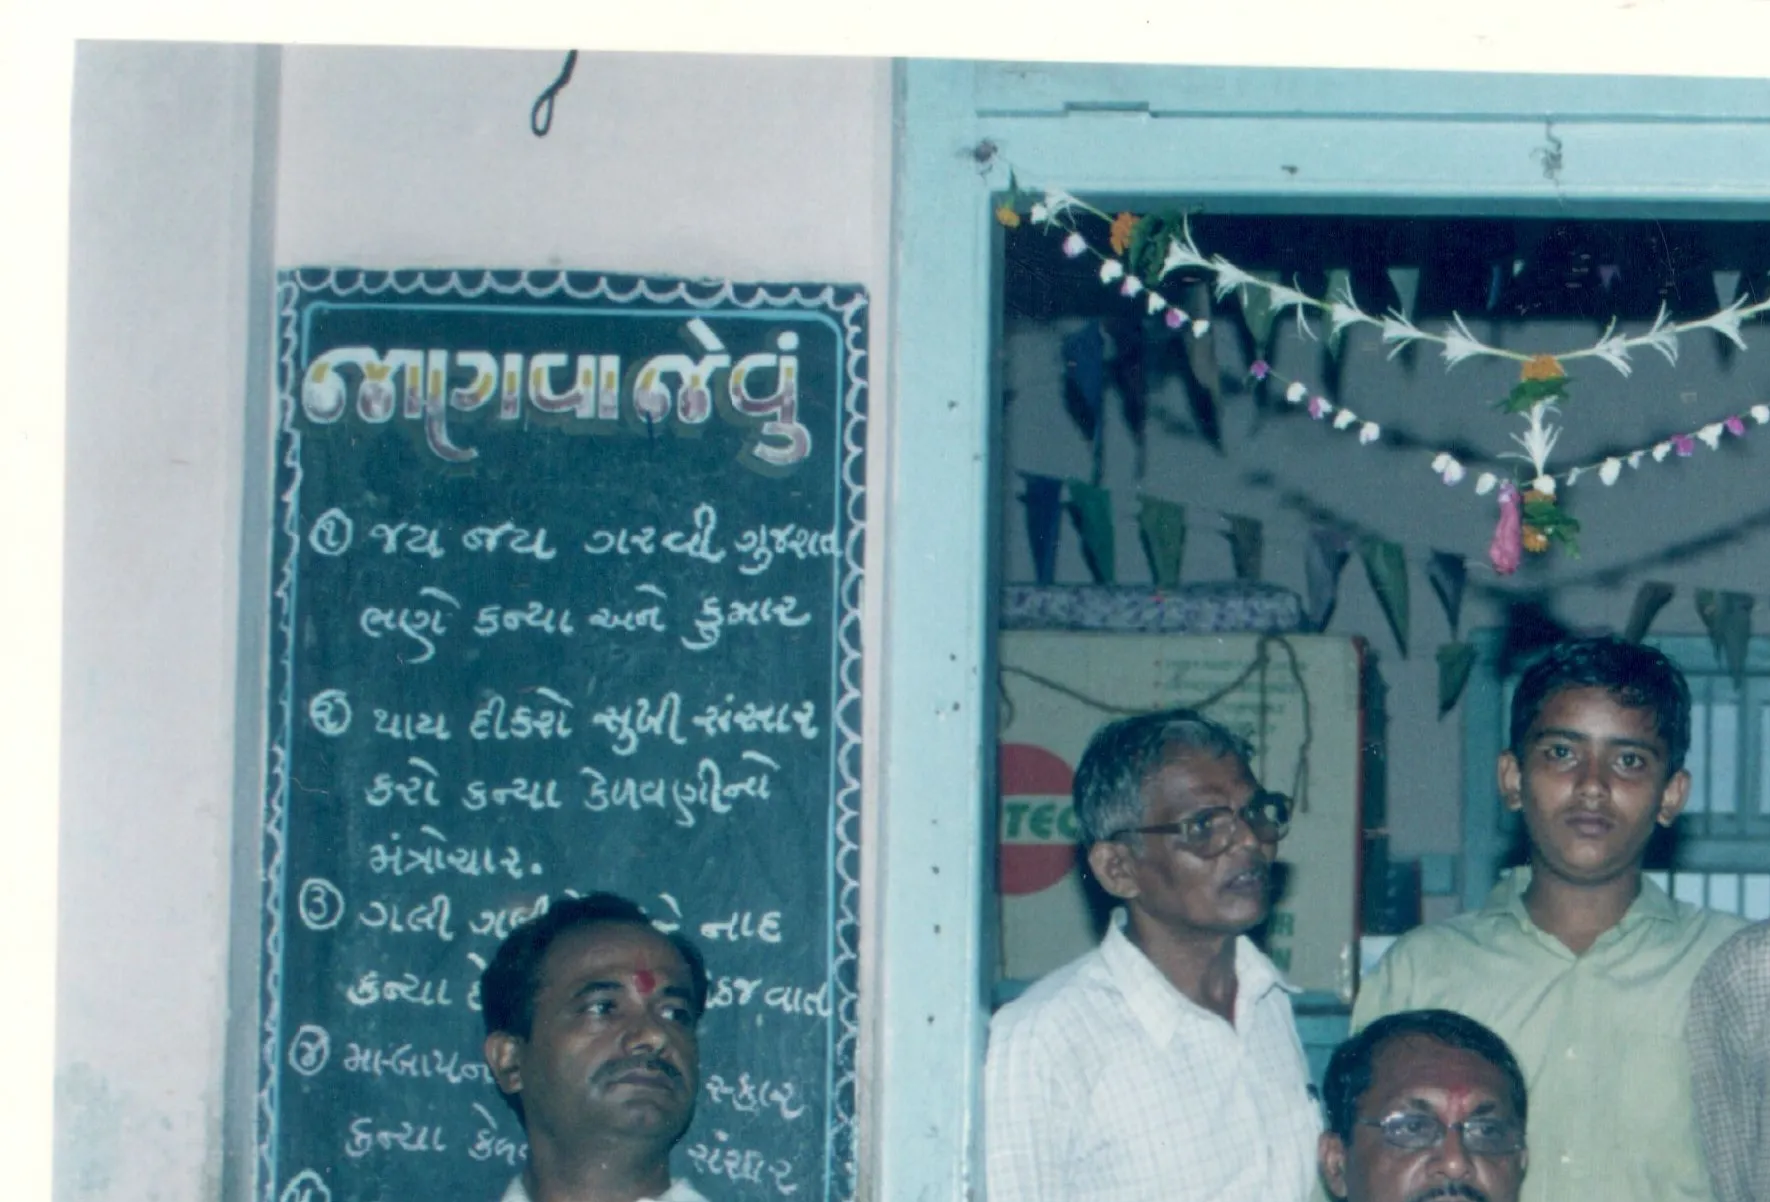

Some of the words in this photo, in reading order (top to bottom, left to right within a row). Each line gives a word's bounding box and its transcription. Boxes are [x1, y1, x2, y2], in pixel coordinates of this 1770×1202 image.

[634, 318, 812, 466] જેવું
[368, 522, 445, 558] જય
[462, 522, 557, 560] જય
[473, 601, 575, 636] કન્યા
[588, 583, 667, 632] અને
[681, 596, 812, 651] કુમાર
[460, 777, 563, 811] કન્યા
[700, 910, 782, 943] નાદ
[346, 970, 453, 1008] કન્યા
[345, 1116, 448, 1158] કન્યા
